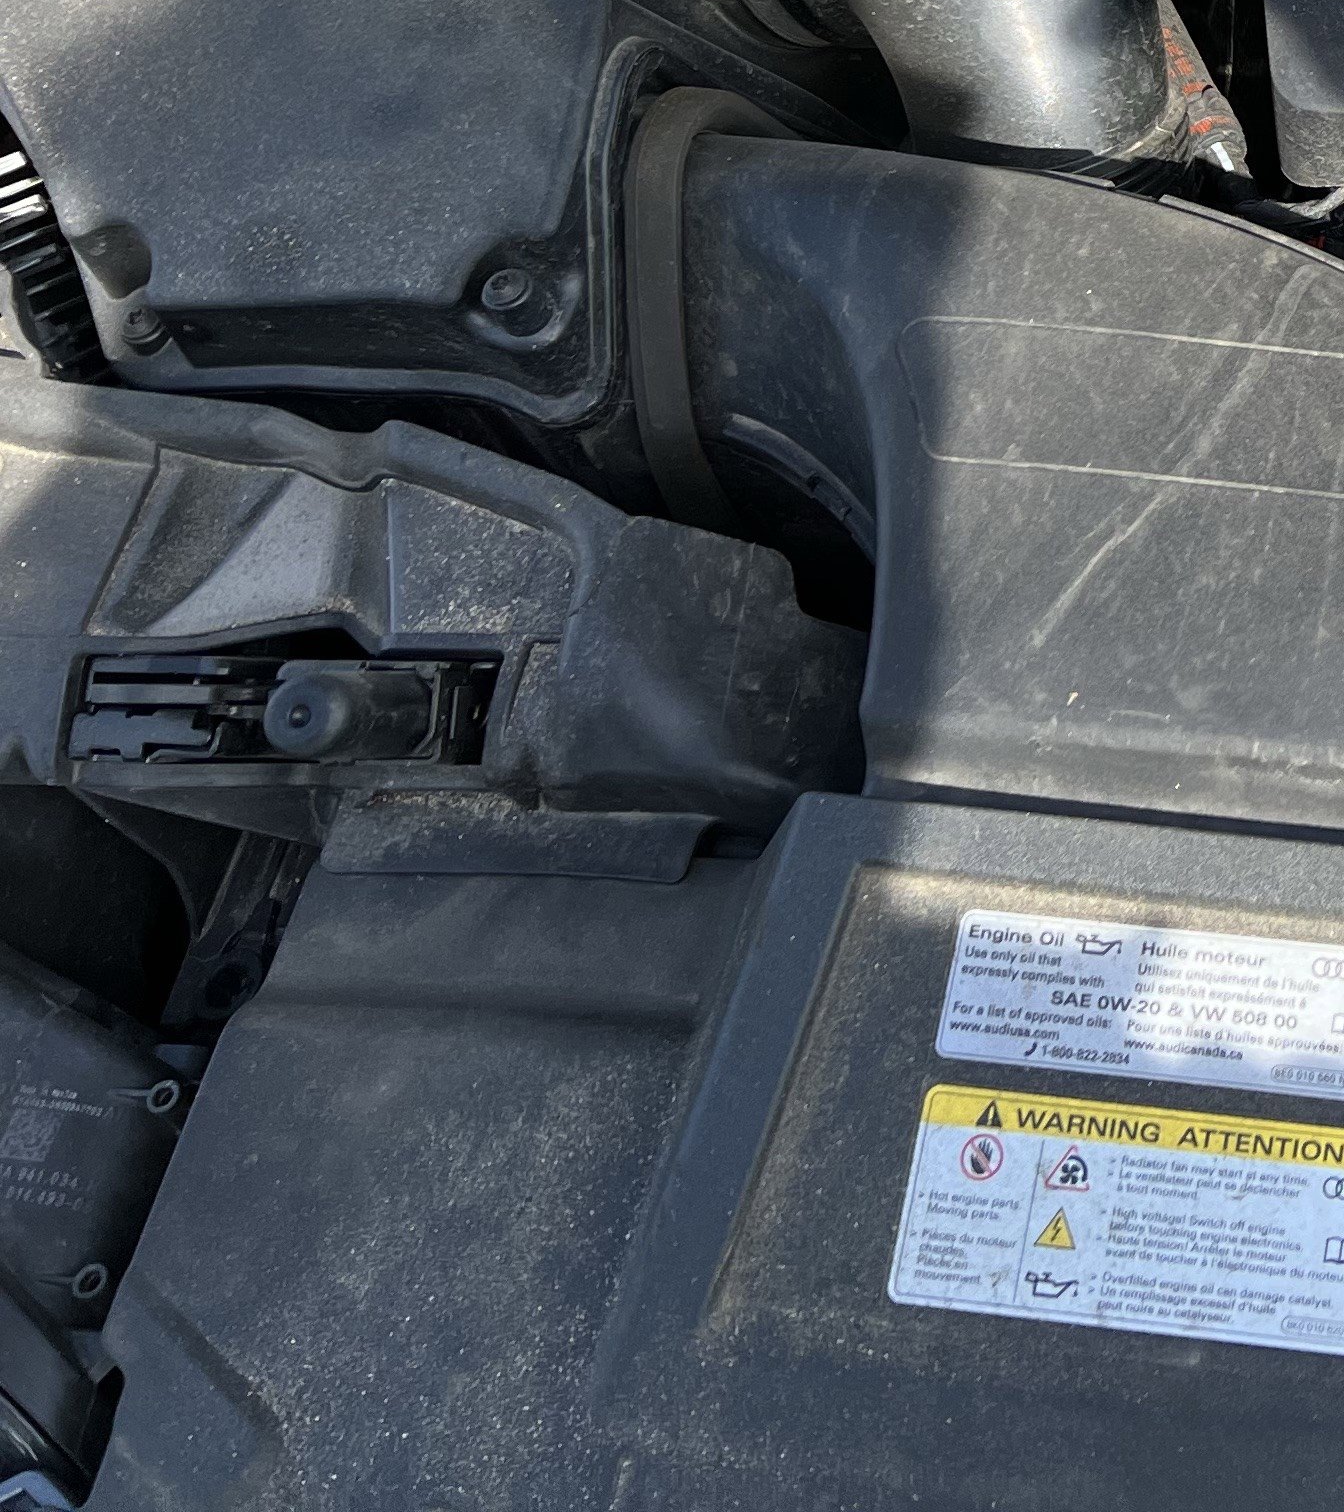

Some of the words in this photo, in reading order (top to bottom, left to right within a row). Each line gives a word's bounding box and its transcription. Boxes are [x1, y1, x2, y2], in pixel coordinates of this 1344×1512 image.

[967, 923, 1034, 946] Engine
[1038, 930, 1065, 947] Oil
[963, 945, 988, 959] Use
[989, 947, 1018, 965] only
[1019, 950, 1036, 963] oil
[1037, 953, 1062, 966] that
[1140, 940, 1189, 959] Huile
[1194, 947, 1267, 968] moteur
[959, 962, 1019, 982] expressly
[1020, 968, 1077, 987] complies
[1078, 974, 1106, 988] with
[1136, 962, 1183, 979] Utilisez
[1184, 967, 1259, 990] uniquement
[1262, 975, 1279, 988] de
[1133, 980, 1155, 996] qui
[951, 1001, 974, 1015] For
[975, 1005, 984, 1016] a
[986, 1003, 1007, 1018] list
[1008, 1006, 1023, 1020] of
[1023, 1008, 1084, 1028] approved
[1050, 989, 1093, 1008] SAE
[1096, 994, 1162, 1015] 0W-20
[1167, 1002, 1184, 1017] &
[1190, 1004, 1227, 1021] VW
[1230, 1009, 1268, 1026] 508
[1273, 1013, 1298, 1030] 00
[948, 1018, 1061, 1041] www.audiusa.com
[1125, 1019, 1156, 1034] Pour
[1158, 1023, 1183, 1037] une
[1185, 1025, 1212, 1039] liste
[1122, 1037, 1244, 1060] www.audicanada.ca
[1014, 1107, 1162, 1144] WARNING
[1170, 1161, 1189, 1173] fan
[1190, 1164, 1214, 1178] may
[1217, 1166, 1242, 1179] start
[1258, 1172, 1280, 1185] any
[925, 1202, 969, 1219] Moving
[928, 1190, 949, 1201] Hot
[950, 1192, 989, 1208] engine
[959, 1232, 975, 1244] du
[975, 1234, 1018, 1249] moteur
[1146, 1224, 1197, 1243] touching
[1199, 1231, 1238, 1247] engine
[1229, 1219, 1245, 1231] off
[1246, 1222, 1286, 1239] engine
[1245, 1249, 1287, 1263] moteur
[1101, 1271, 1157, 1288] Overfilled
[1157, 1278, 1198, 1295] engine
[1216, 1286, 1237, 1298] can
[1239, 1287, 1286, 1305] damage
